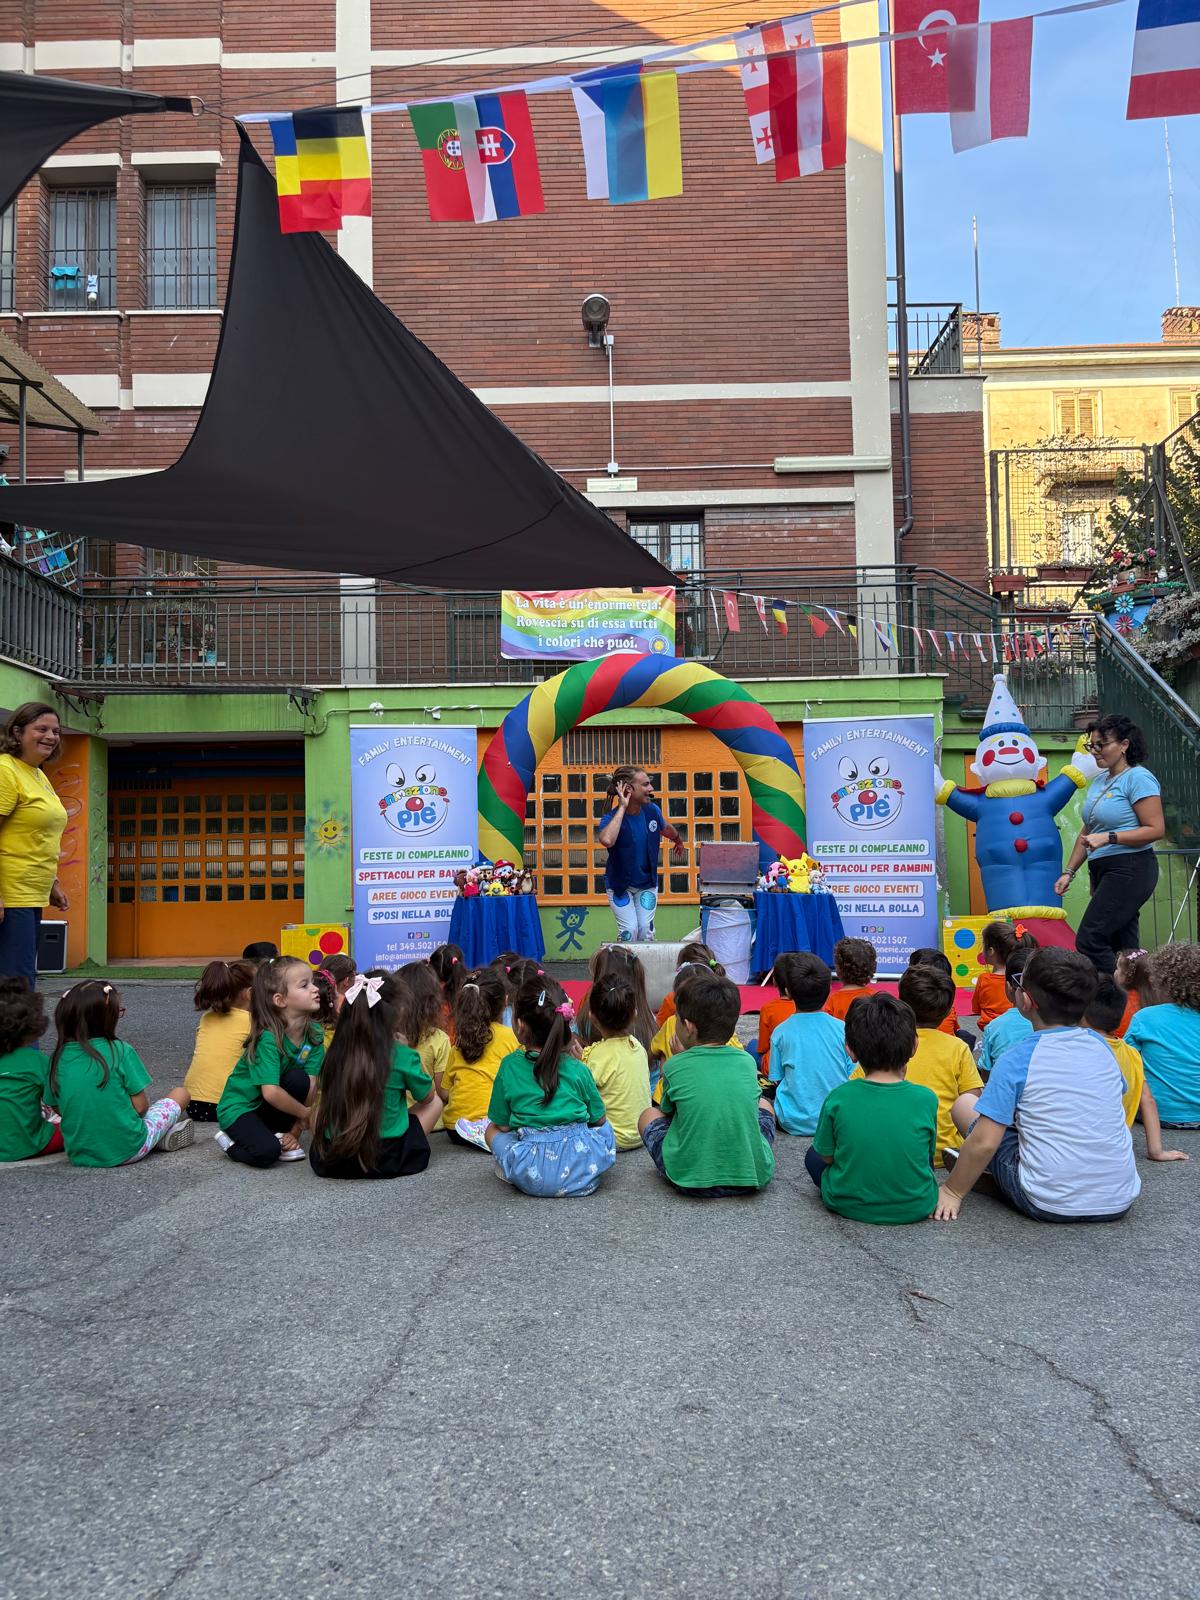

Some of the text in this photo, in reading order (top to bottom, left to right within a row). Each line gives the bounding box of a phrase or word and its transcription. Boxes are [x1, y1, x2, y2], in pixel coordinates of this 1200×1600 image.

[515, 597, 662, 610] La vita è un'enorme tela:
[515, 615, 658, 629] Rovescia su di essa tutti
[538, 635, 543, 647] i
[545, 635, 581, 648] colori
[583, 636, 604, 648] che
[607, 637, 638, 650] puoi.
[811, 728, 928, 760] FAMILY ENTERTAINMENT
[358, 736, 473, 766] FAMILY ENTERTAINMENT
[363, 849, 469, 860] FESTE DI COMPLEANNO
[816, 844, 925, 853] FESTE DI COMPLEANNO
[819, 863, 933, 873] PETTACOLI PER BAMBINI
[358, 870, 415, 881] SPETTACOLI
[417, 869, 435, 879] PER
[831, 884, 919, 893] REE GIOCO EVENTI
[372, 889, 458, 901] AREE GIOCO EVENT
[372, 908, 451, 920] SPOSI NELLA BOL
[855, 904, 885, 913] NELLA
[889, 904, 919, 913] BOLLA
[387, 942, 397, 951] tel
